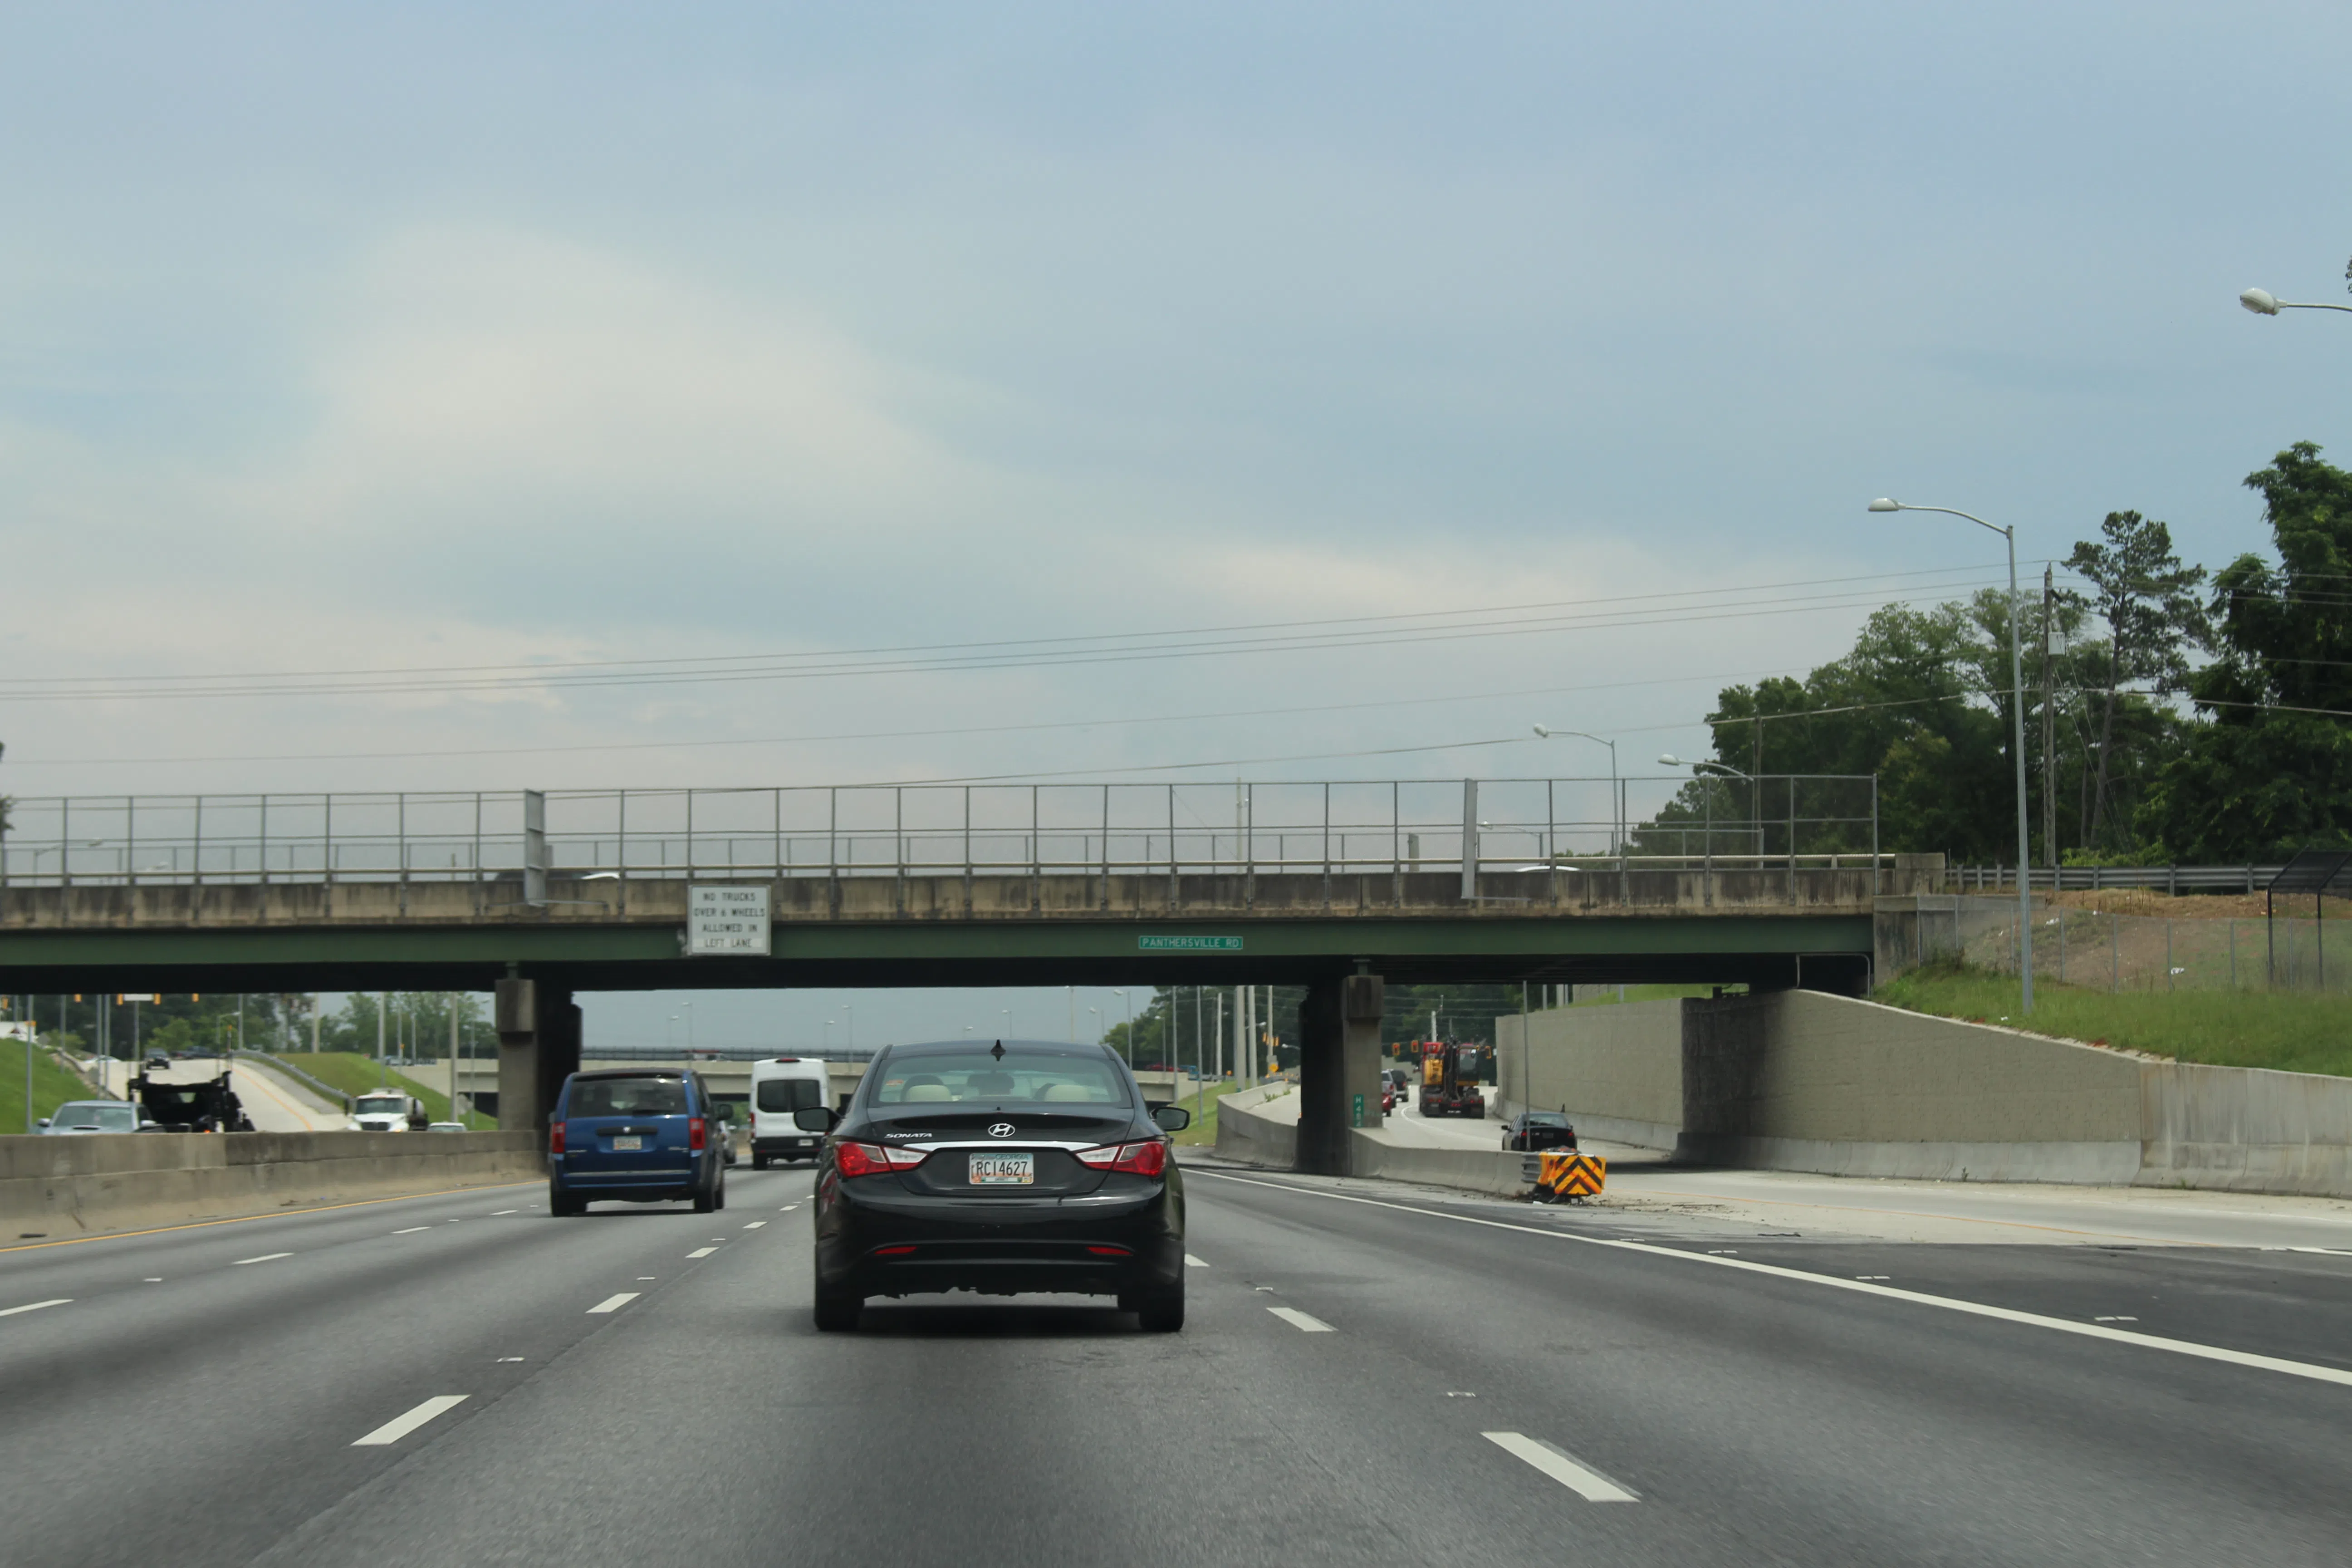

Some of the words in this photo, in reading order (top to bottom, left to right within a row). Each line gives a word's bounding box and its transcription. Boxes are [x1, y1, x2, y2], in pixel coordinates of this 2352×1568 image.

[703, 892, 715, 902] NO
[722, 892, 756, 902] TRUCKS
[694, 908, 717, 916] OVER
[720, 908, 726, 916] 6
[731, 908, 765, 916] WHEELS
[702, 924, 743, 932] ALLOWED
[749, 924, 757, 932] IN
[705, 939, 725, 947] LEFT
[731, 939, 753, 947] LANE
[1142, 938, 1220, 947] PANTHERSVILLE
[1225, 938, 1239, 947] RD
